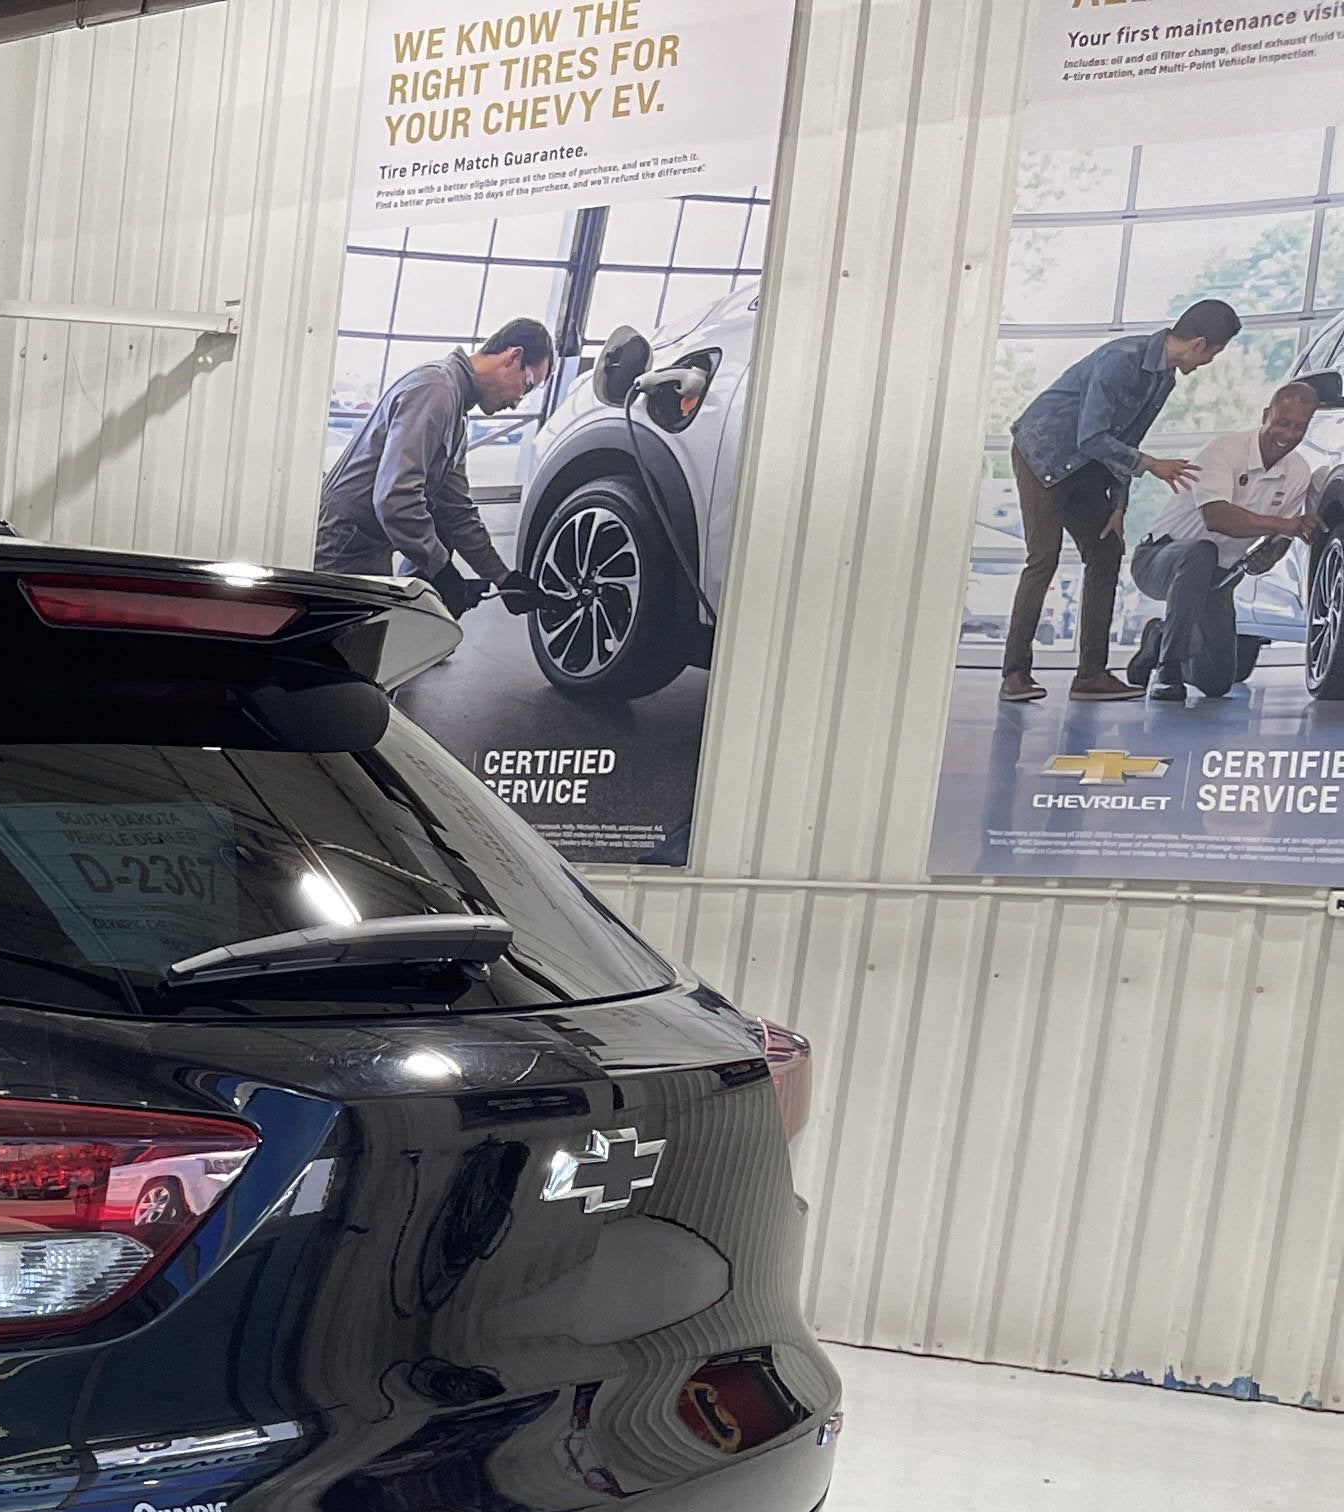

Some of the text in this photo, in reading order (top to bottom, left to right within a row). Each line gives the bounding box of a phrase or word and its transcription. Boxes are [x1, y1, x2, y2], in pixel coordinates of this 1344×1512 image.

[393, 0, 641, 64] WE KNOW THE
[1068, 30, 1111, 48] Your
[1116, 24, 1160, 45] first
[1165, 10, 1297, 39] maintenance
[1062, 71, 1091, 82] 4-tire
[1093, 68, 1136, 80] rotation,
[1138, 65, 1157, 76] and
[1158, 59, 1216, 75] Multi-Point
[1218, 56, 1256, 68] Vehicle
[1063, 57, 1108, 69] Includes:
[1110, 55, 1123, 65] oil
[1124, 53, 1144, 63] and
[1145, 51, 1159, 61] oil
[1160, 49, 1187, 61] filter
[1188, 45, 1229, 58] change,
[1231, 40, 1263, 53] diesel
[1264, 35, 1307, 49] exhaust
[1309, 31, 1335, 42] fluid
[387, 34, 680, 105] RIGHT TIRES FOR
[384, 79, 666, 146] YOUR CHEVY EV.
[376, 187, 405, 199] Provide
[407, 188, 416, 197] us
[418, 185, 435, 195] with
[443, 182, 468, 192] better
[470, 178, 498, 190] eligible
[499, 176, 521, 187] price
[522, 173, 531, 182] at
[532, 172, 546, 181] the
[548, 170, 567, 180] time
[568, 168, 577, 177] of
[578, 164, 620, 178] purchase,
[621, 160, 637, 170] and
[660, 154, 688, 165] match
[379, 144, 588, 180] Tire Price Match Guarantee.
[375, 200, 392, 211] Find
[400, 198, 424, 208] better
[425, 196, 445, 208] price
[447, 193, 472, 203] within
[473, 192, 484, 200] 30
[485, 189, 504, 200] days
[505, 186, 515, 197] of
[516, 186, 530, 196] the
[531, 180, 571, 195] purchase,
[572, 178, 589, 188] and
[611, 172, 640, 184] refund
[641, 170, 655, 180] the
[484, 749, 616, 775] CERTIFIED
[1032, 793, 1172, 812] CHEVROLET
[1196, 784, 1340, 814] SERVICE
